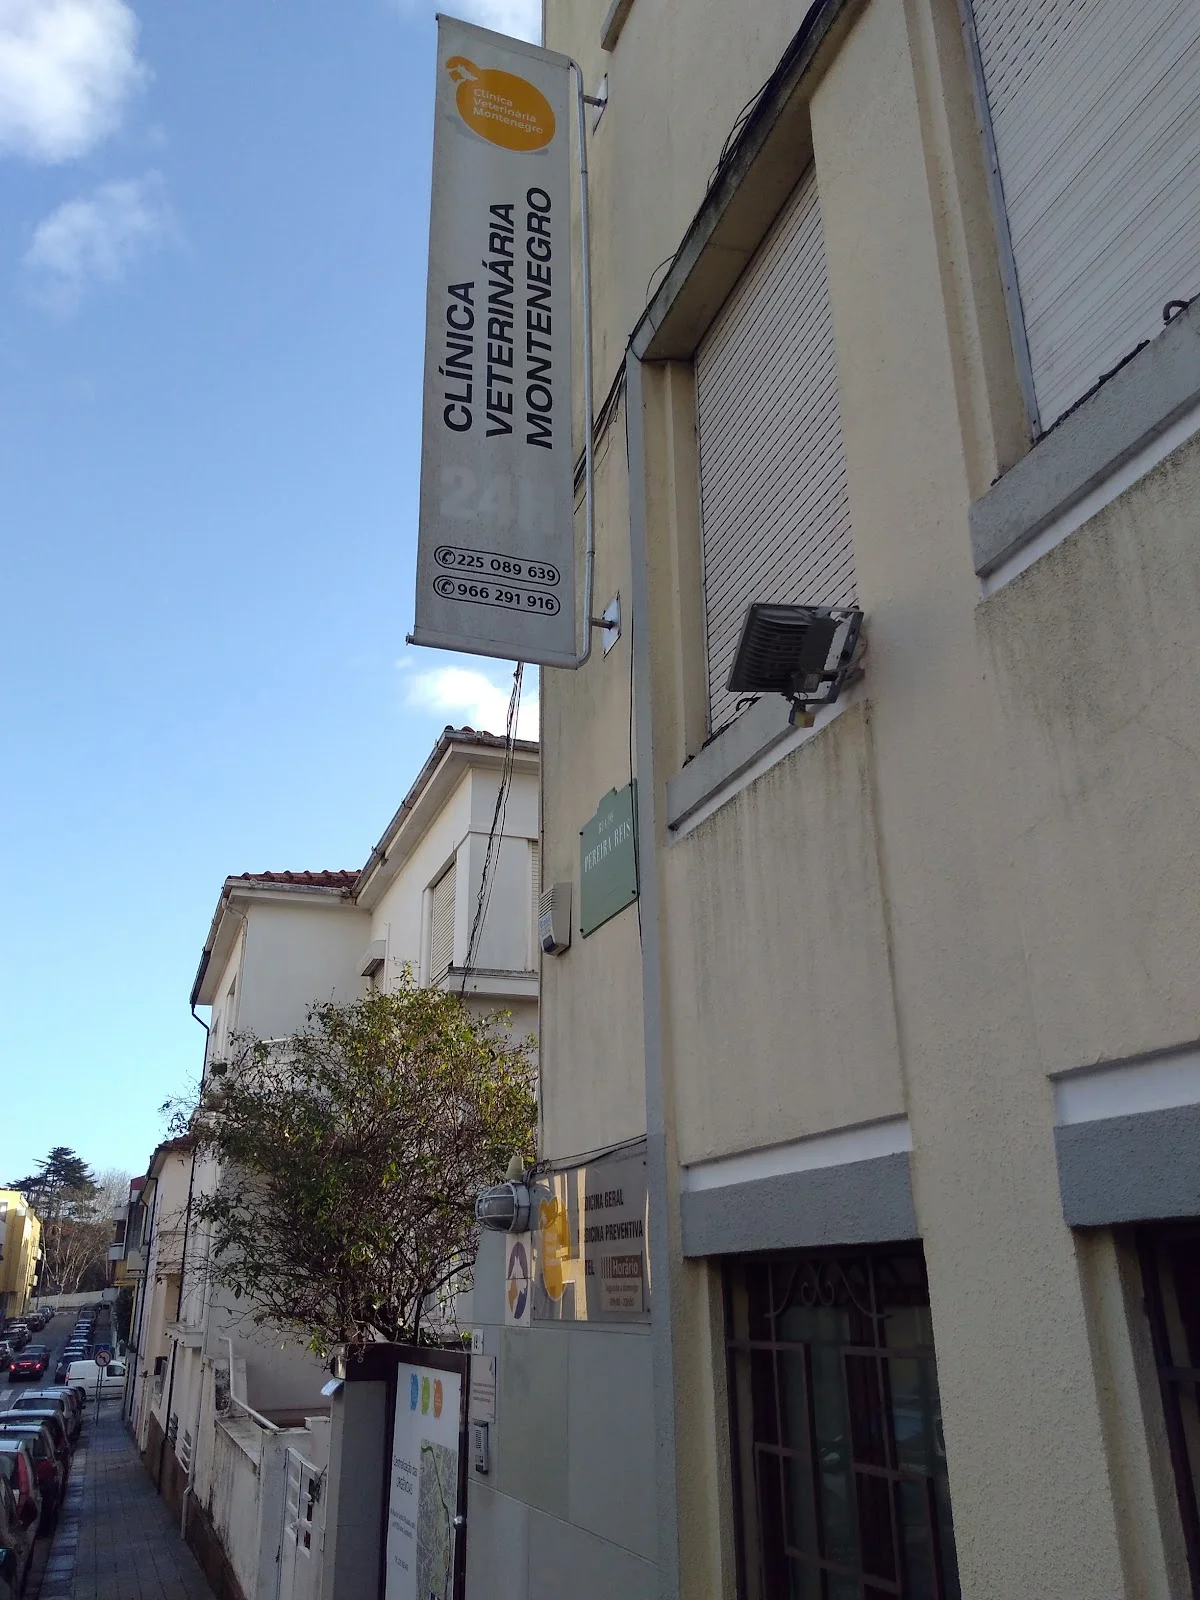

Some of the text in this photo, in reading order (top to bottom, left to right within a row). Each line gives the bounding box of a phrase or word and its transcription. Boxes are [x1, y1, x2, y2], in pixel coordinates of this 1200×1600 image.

[473, 107, 543, 134] Montenegro
[481, 203, 515, 438] VETERINÁRIA
[525, 187, 553, 450] MONTENEGRO
[438, 281, 475, 432] CLÍNICA
[457, 553, 556, 582] 225 089 639
[457, 583, 555, 611] 966 291 916
[584, 817, 632, 873] PEREIRA REIS
[604, 1188, 624, 1207] GERAL
[605, 1219, 644, 1241] PREVENTIVA
[612, 1257, 639, 1275] Horário
